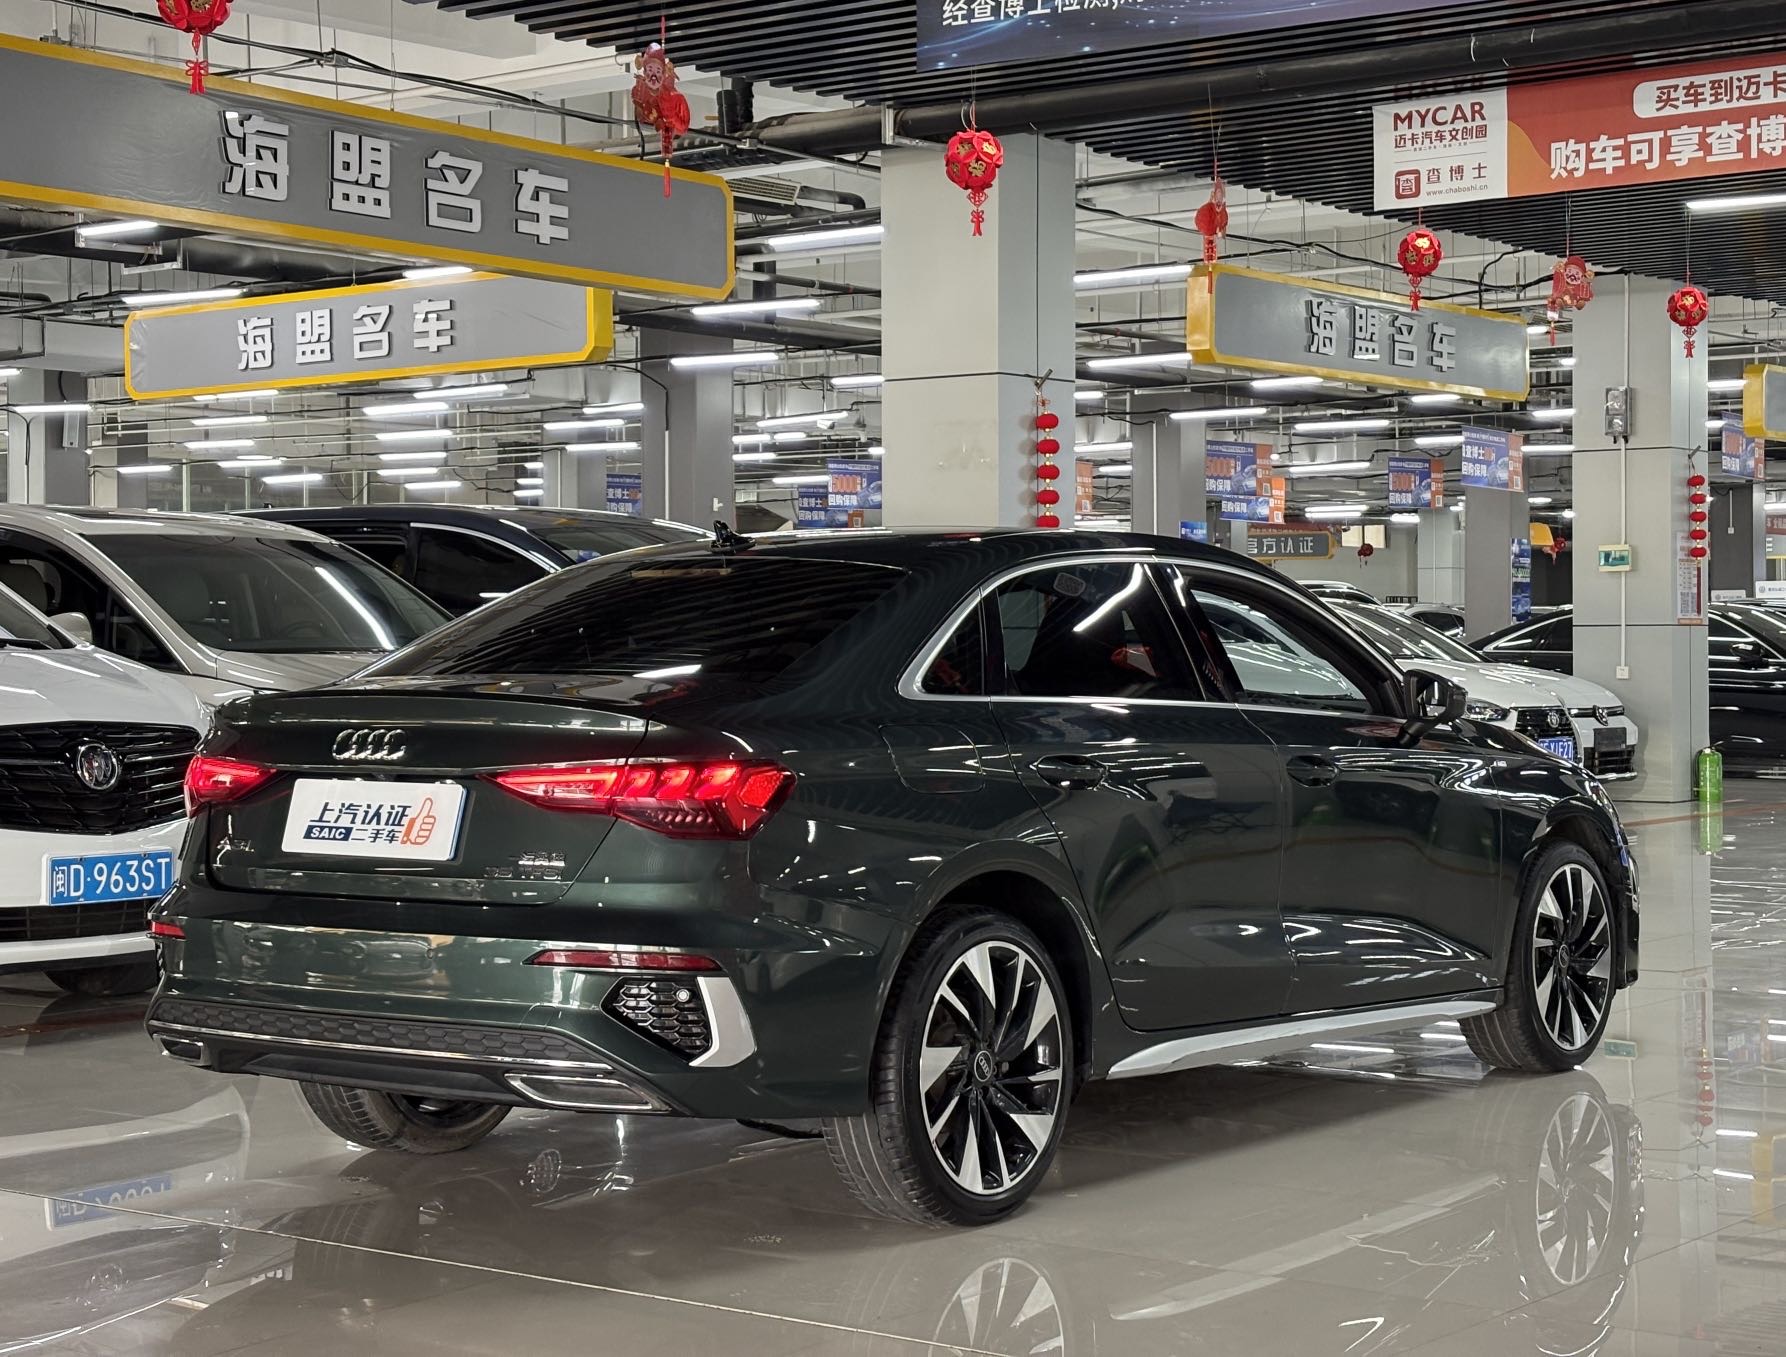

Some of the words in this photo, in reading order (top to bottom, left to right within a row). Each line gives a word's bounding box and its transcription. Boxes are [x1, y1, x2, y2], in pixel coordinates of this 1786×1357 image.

[1655, 71, 1786, 112] 买车到迈卡
[1393, 101, 1486, 131] MYCAR
[1394, 124, 1488, 149] 迈卡汽车文创园
[1550, 114, 1786, 180] 购车可享查博
[219, 110, 569, 245] 海盟名车
[1426, 162, 1488, 184] 查博士
[1426, 184, 1488, 196] www.chaboshi.cn
[237, 299, 453, 371] 海盟名车
[1305, 298, 1456, 372] 海盟名车
[310, 802, 412, 826] 上汽认证
[310, 828, 346, 839] SAIC
[351, 828, 402, 844] 二手车
